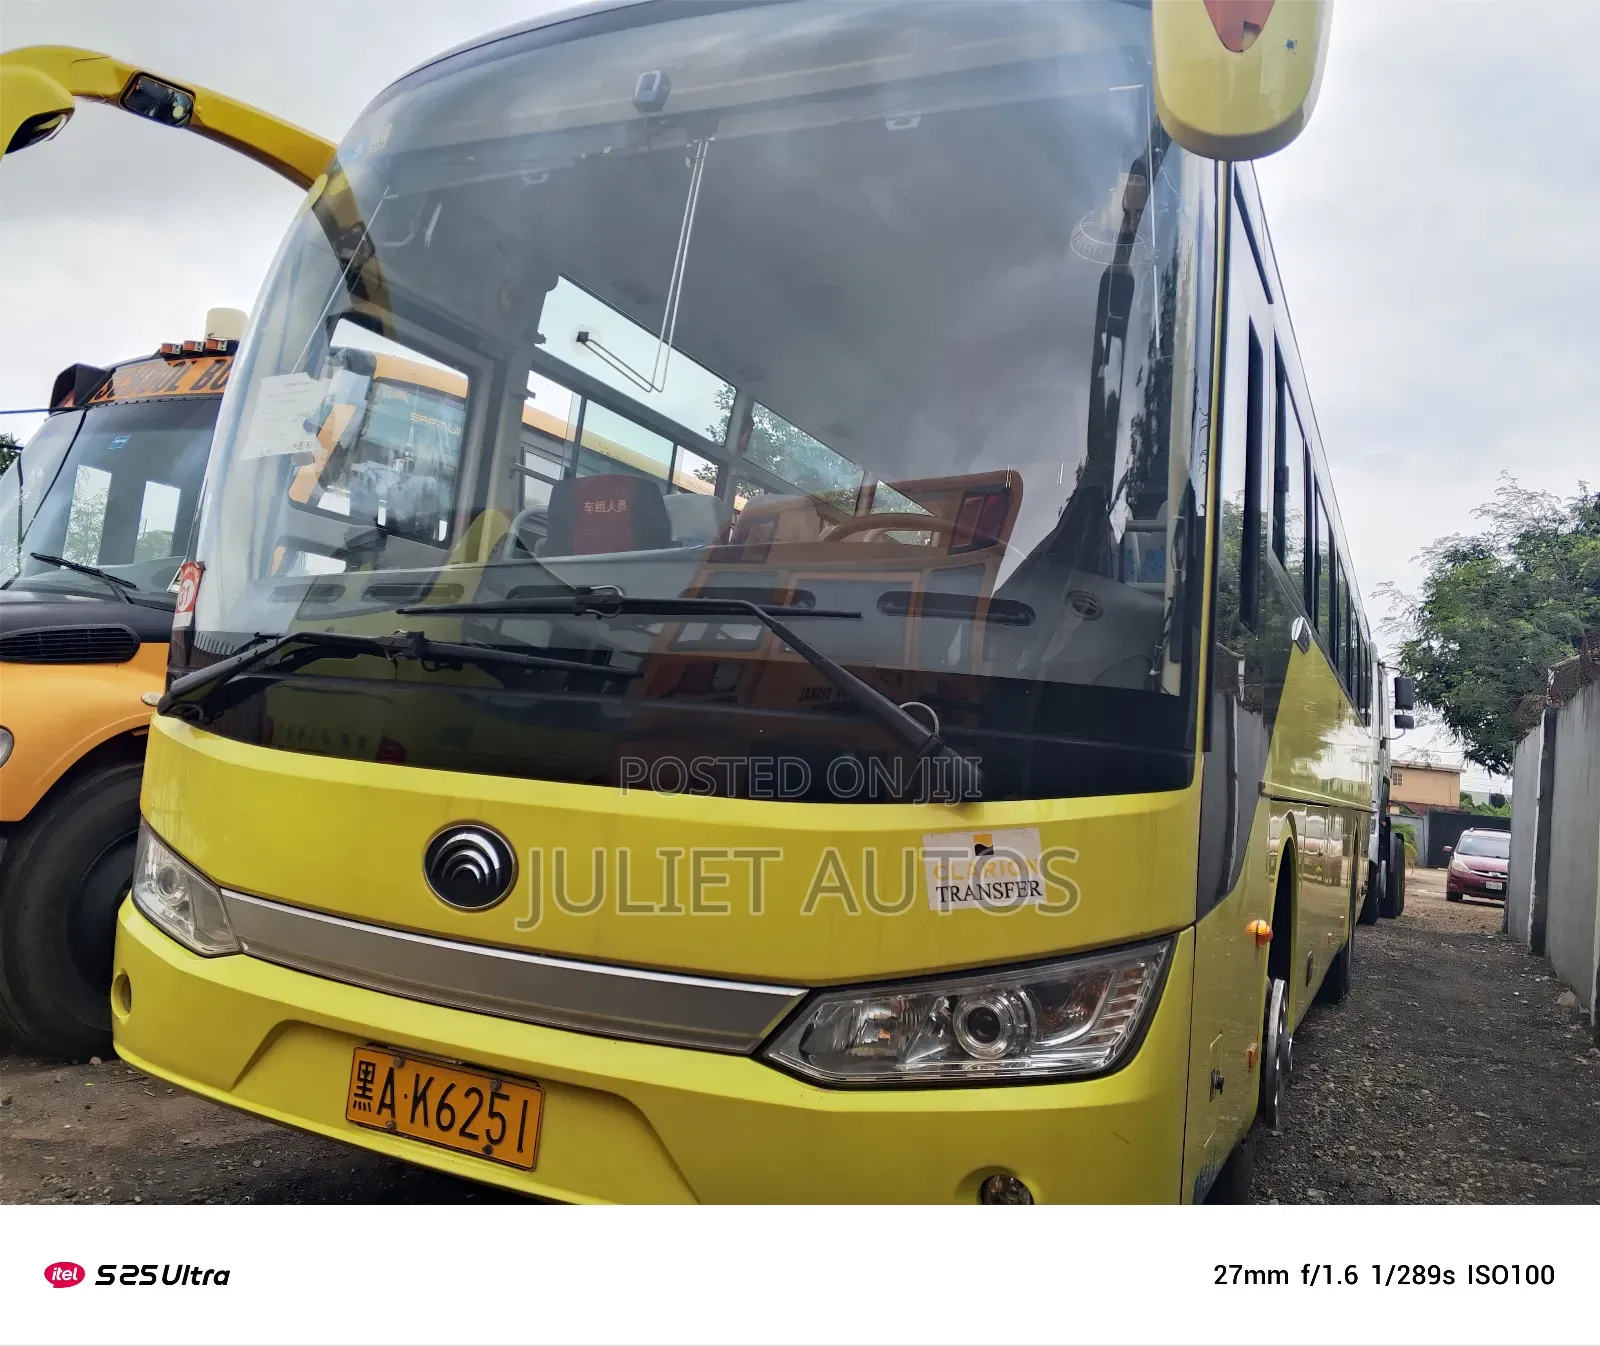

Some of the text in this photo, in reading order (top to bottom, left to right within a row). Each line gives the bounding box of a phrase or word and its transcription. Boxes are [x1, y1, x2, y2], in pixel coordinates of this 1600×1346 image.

[583, 499, 628, 514] 车组人员
[934, 857, 1039, 880] CLARION
[936, 881, 1043, 902] TRANSFER
